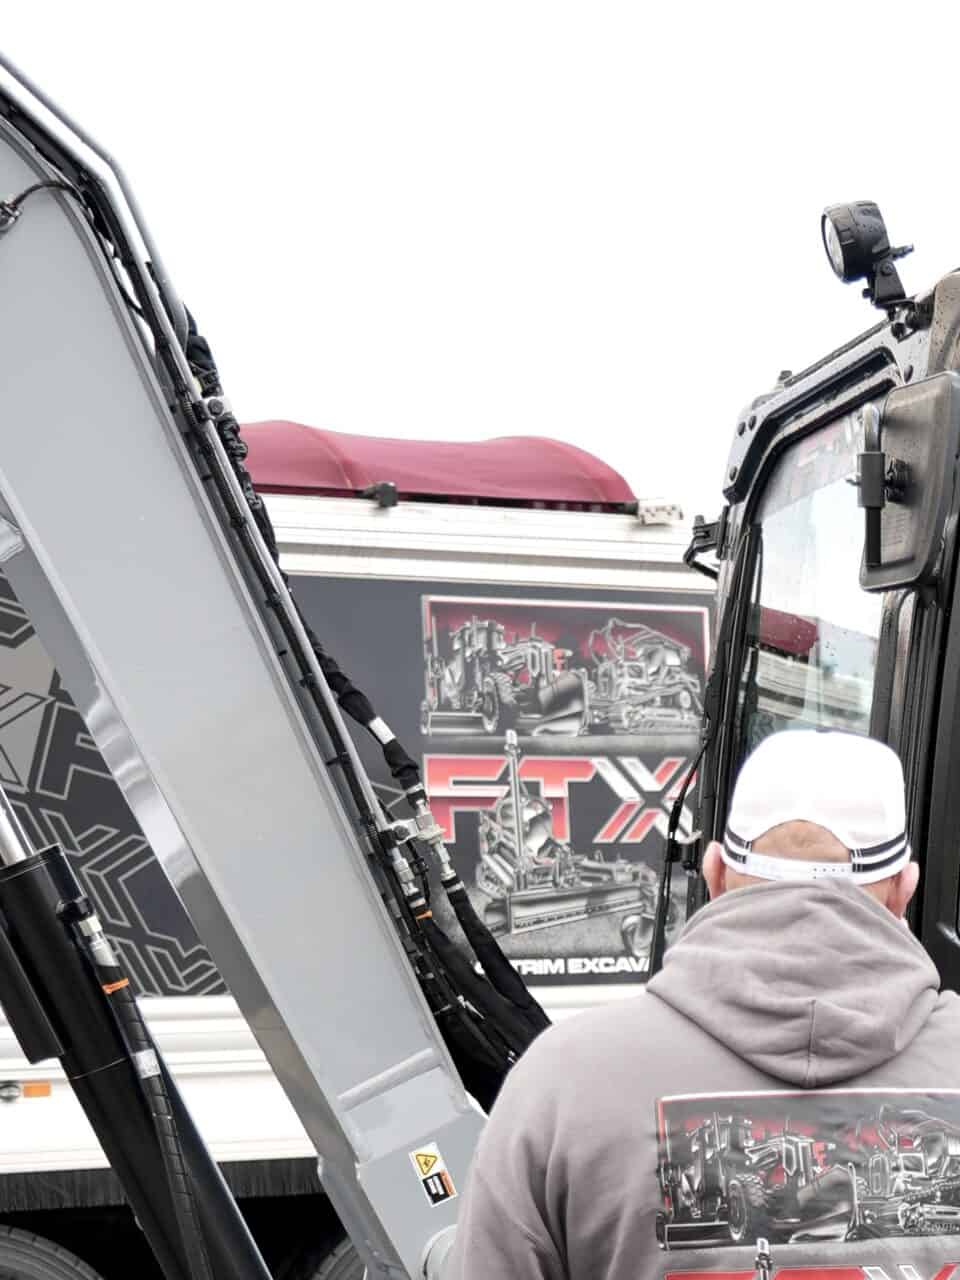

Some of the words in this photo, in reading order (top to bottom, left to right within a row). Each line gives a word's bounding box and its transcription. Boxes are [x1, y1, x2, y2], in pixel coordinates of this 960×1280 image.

[423, 754, 698, 845] FTX
[508, 957, 566, 976] TRIM
[567, 955, 650, 975] EXCAV
